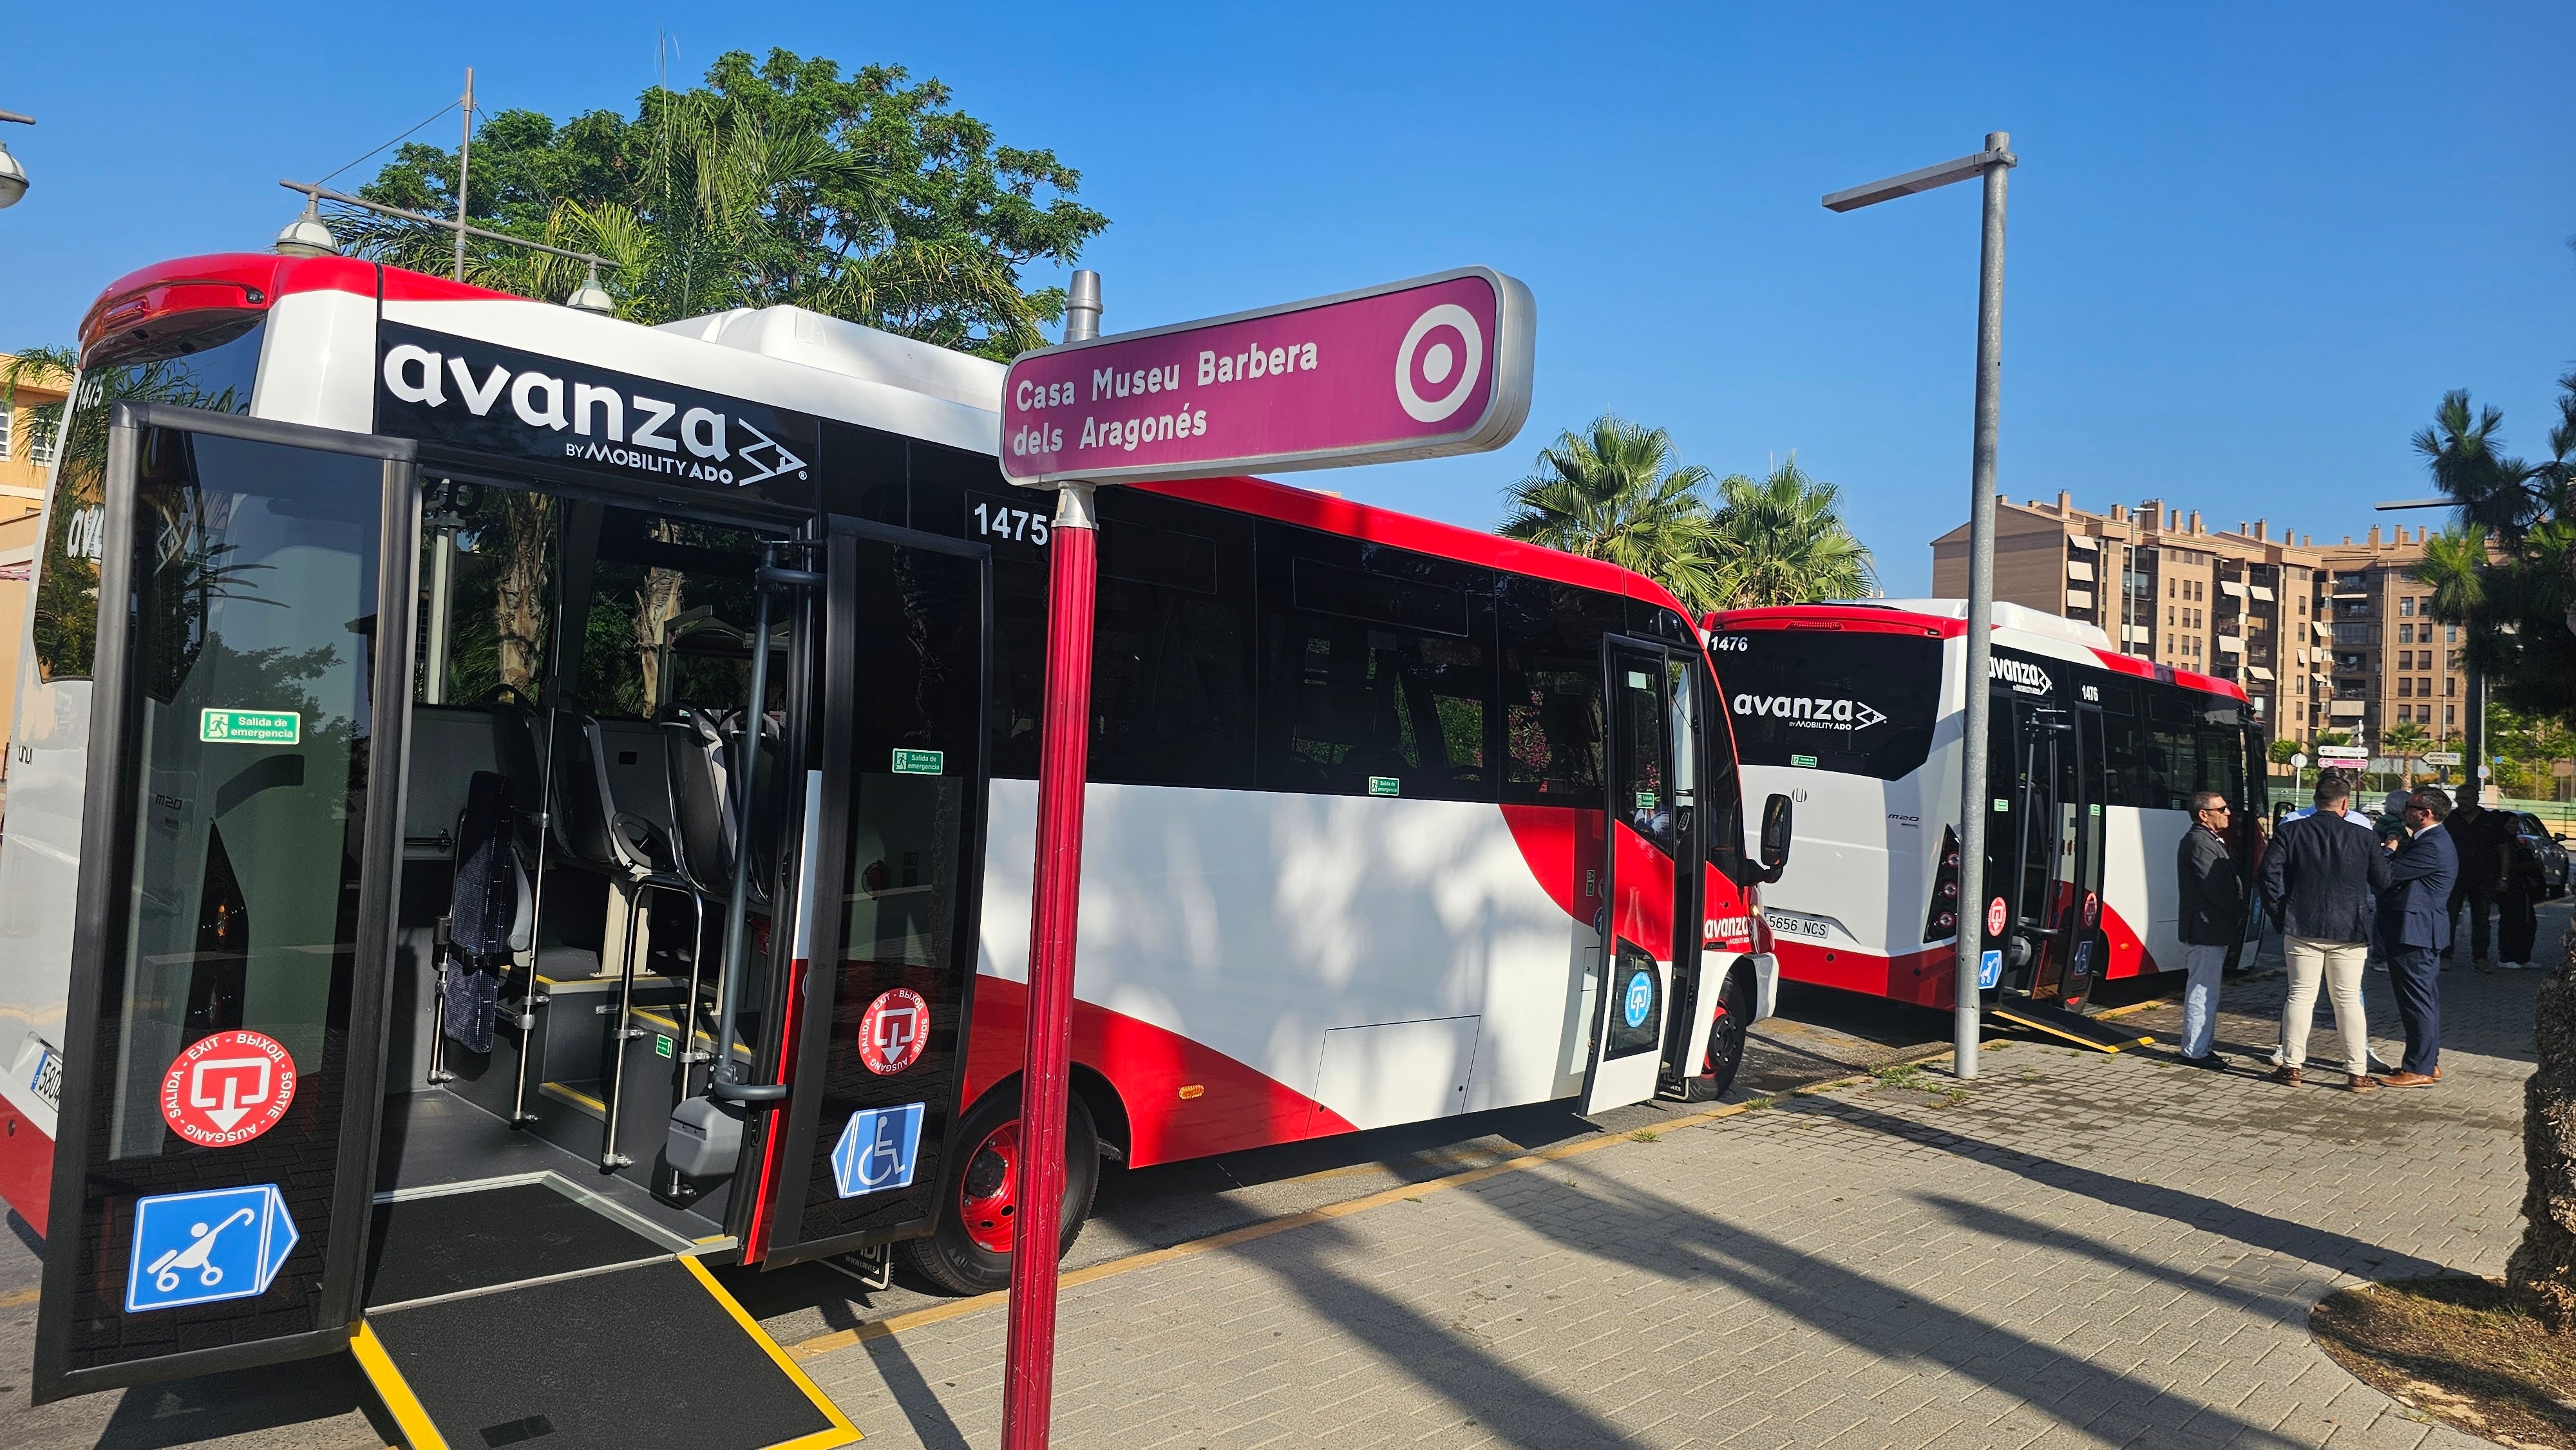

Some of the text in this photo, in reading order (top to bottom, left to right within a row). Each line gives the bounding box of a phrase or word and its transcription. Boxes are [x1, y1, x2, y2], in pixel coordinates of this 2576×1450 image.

[1016, 342, 1318, 412] Casa Museu Barbera
[77, 376, 105, 412] 1475
[384, 344, 730, 458] avanza
[1013, 402, 1208, 457] dels Aragonés
[566, 442, 734, 484] BY MOBILITY ADO
[974, 503, 1048, 546] 1475
[1711, 636, 1748, 652] 1476
[2081, 684, 2099, 702] 1476
[1733, 693, 1853, 721] avanza
[231, 728, 294, 739] emergencia
[238, 717, 288, 727] Salida de
[1795, 720, 1833, 730] MOBILITY
[1704, 916, 1749, 939] avanza
[1769, 916, 1826, 936] 5656 NCS
[873, 992, 891, 1010] EXIT
[899, 990, 925, 1012] ВЫХОД
[236, 1033, 285, 1063] ВЫХОД
[861, 1018, 872, 1054] SALIDA
[913, 1018, 927, 1053] SORTIE
[187, 1037, 218, 1060] EXIT
[869, 1057, 908, 1072] AUSGANG
[165, 1070, 184, 1118] SALIDA
[267, 1071, 293, 1119] SORTIE
[184, 1123, 257, 1143] AUSGANG
